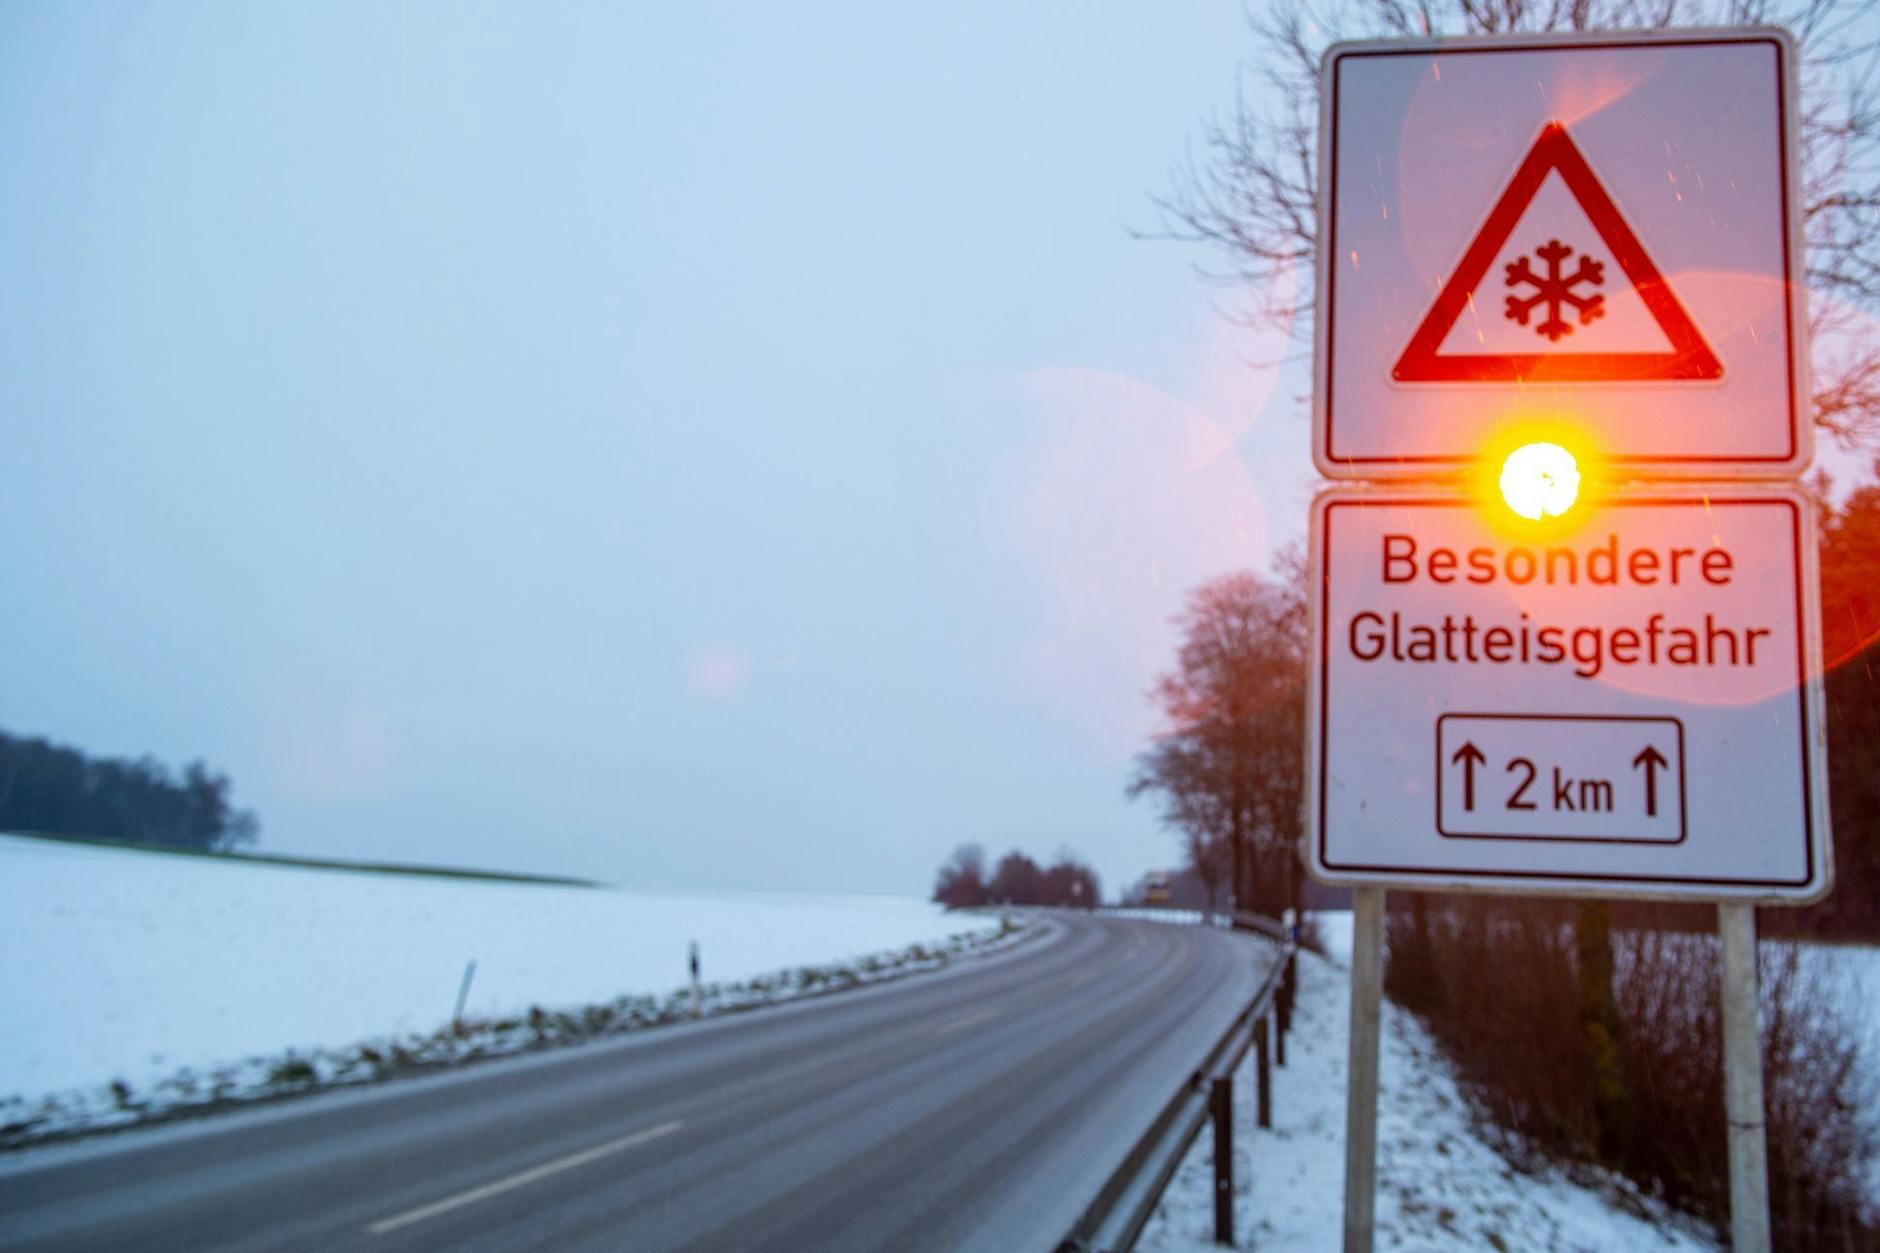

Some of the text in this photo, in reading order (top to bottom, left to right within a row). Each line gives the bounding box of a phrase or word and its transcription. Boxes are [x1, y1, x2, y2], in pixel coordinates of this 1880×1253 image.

[1382, 533, 1734, 585] Besondere
[1348, 611, 1771, 679] Glatteisgefahr
[1506, 757, 1614, 812] 2 km
